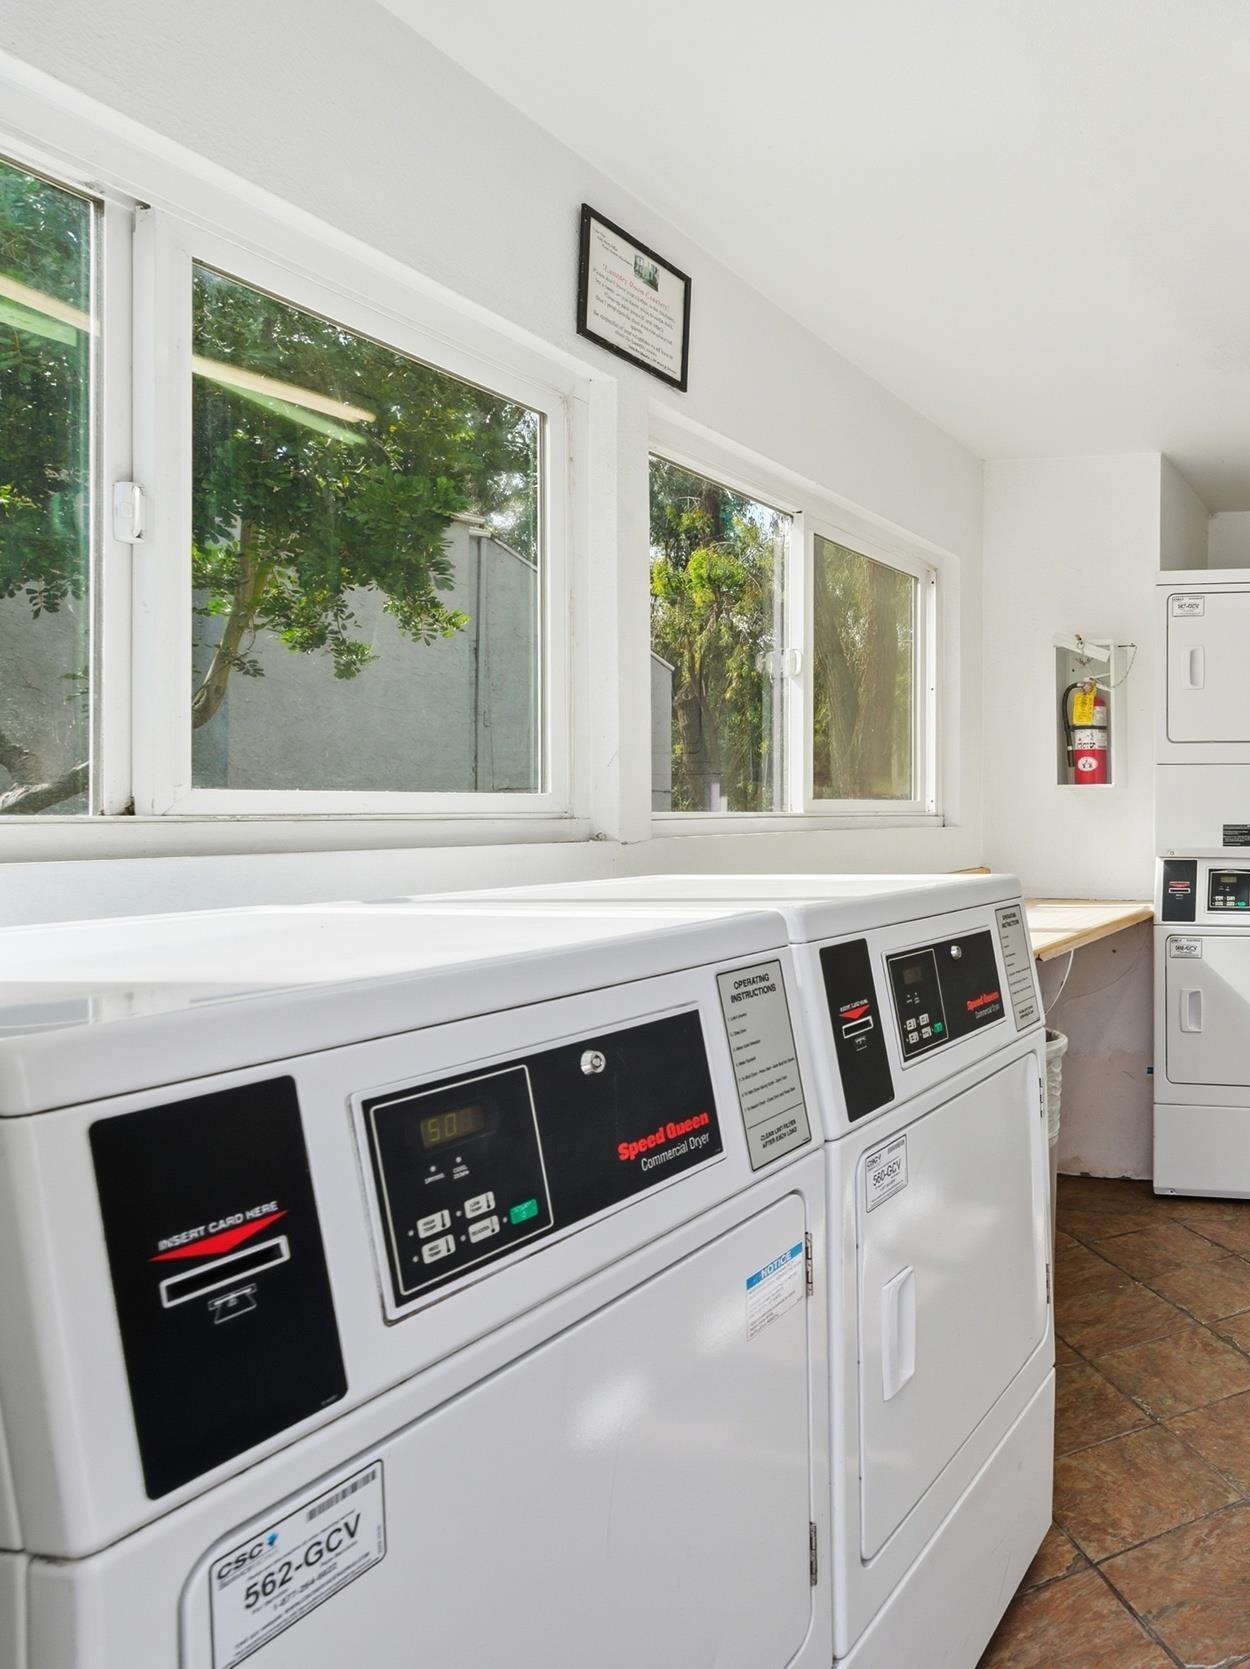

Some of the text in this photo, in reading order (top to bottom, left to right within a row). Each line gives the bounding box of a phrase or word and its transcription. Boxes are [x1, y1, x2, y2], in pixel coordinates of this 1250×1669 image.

[730, 983, 777, 1003] INSTRUCTIONS
[733, 973, 770, 990] OPERATING
[617, 1111, 709, 1161] Speed Queen
[641, 1132, 710, 1171] Commercial Dryer
[158, 1200, 279, 1252] INSERT CARD HERE
[760, 1250, 793, 1279] NOTICE
[216, 1542, 264, 1581] CSC
[244, 1511, 361, 1610] 562-GCV
